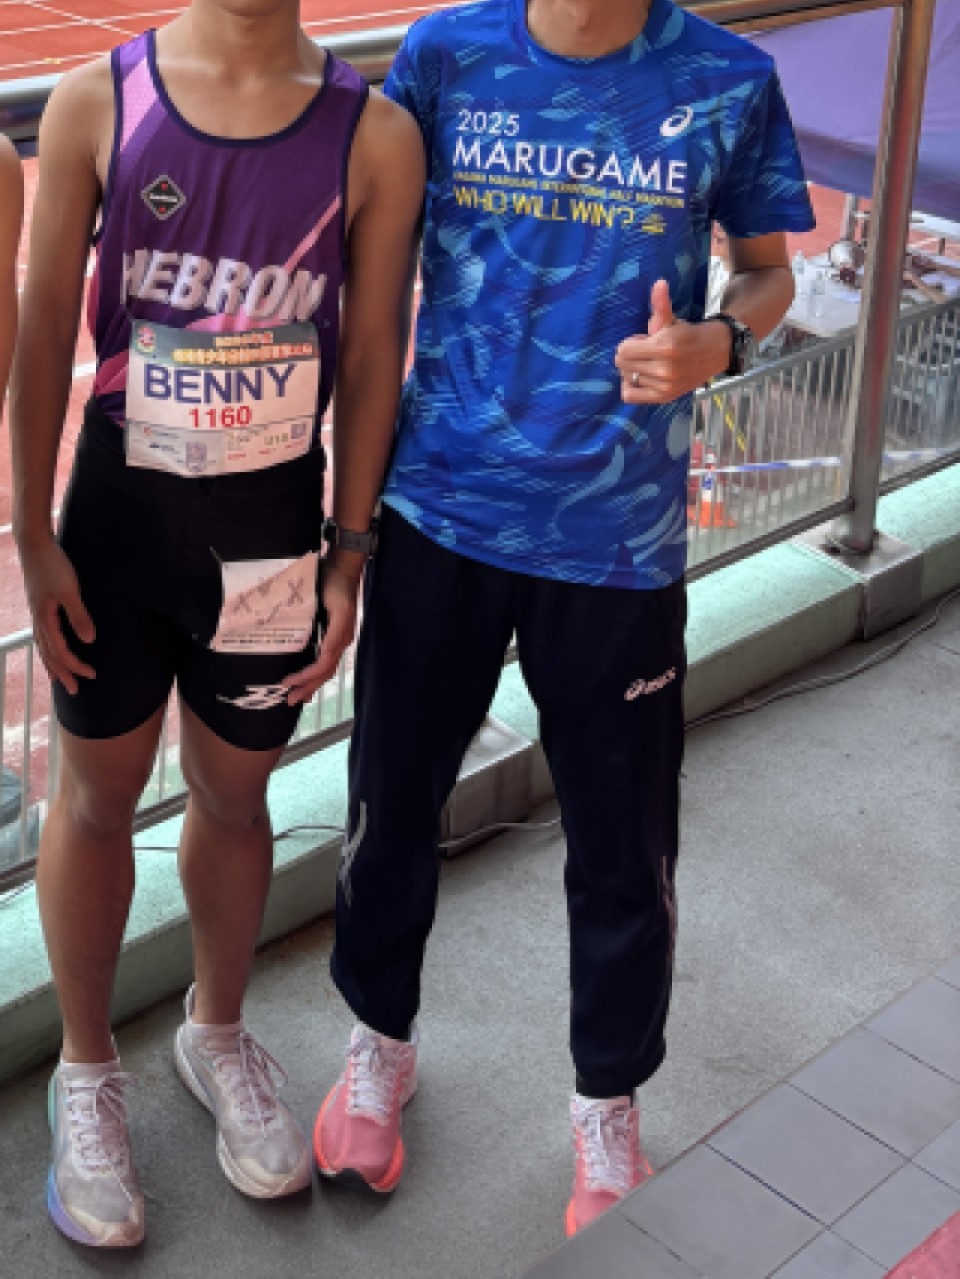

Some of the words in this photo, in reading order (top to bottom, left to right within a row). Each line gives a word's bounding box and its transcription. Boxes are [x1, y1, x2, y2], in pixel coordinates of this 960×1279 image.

[455, 108, 520, 137] 2025
[452, 135, 688, 194] MARUGAME
[453, 186, 507, 215] WHO
[512, 192, 567, 221] WILL
[120, 248, 328, 320] HEBRON
[143, 363, 296, 404] BENNY
[189, 405, 252, 428] 1160
